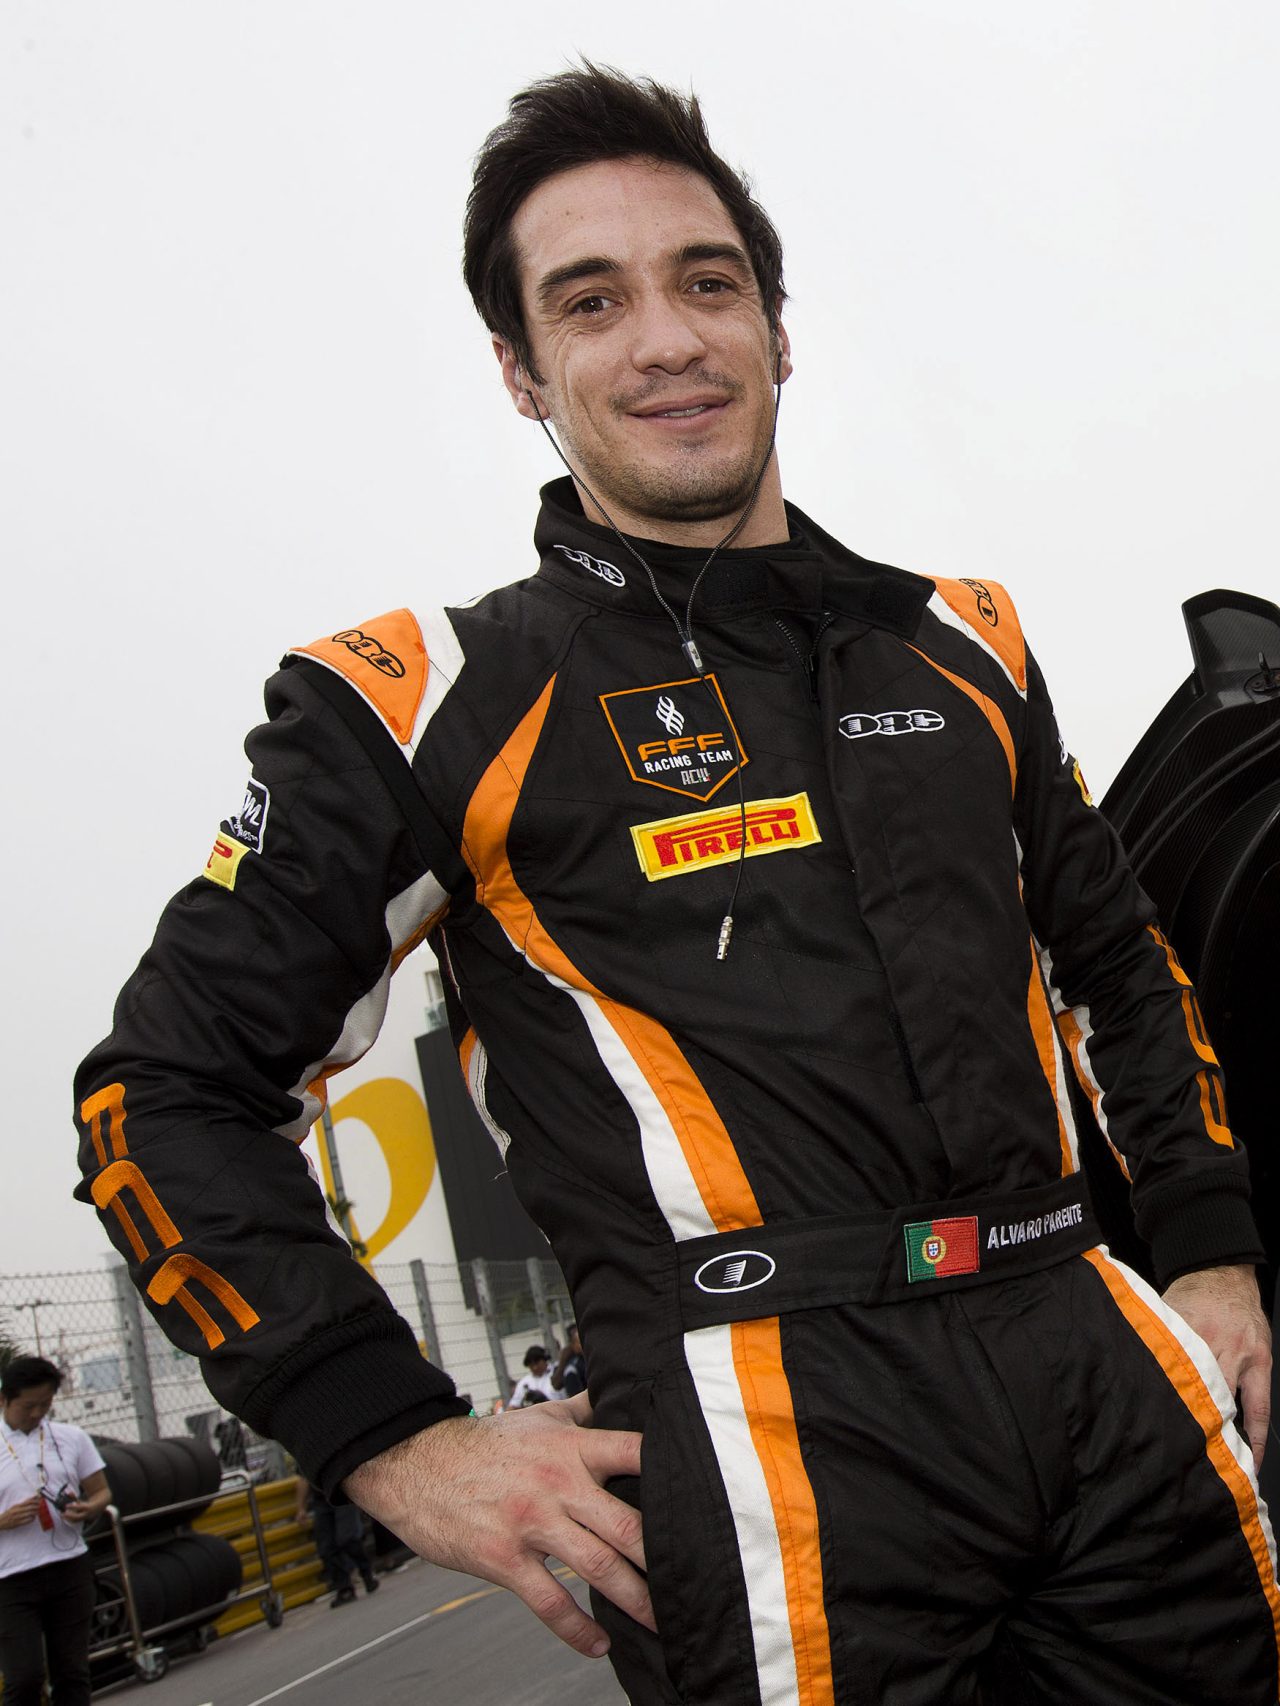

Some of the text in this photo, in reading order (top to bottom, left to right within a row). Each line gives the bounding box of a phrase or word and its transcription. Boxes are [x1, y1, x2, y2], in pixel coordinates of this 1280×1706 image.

[637, 732, 725, 762] FFF
[643, 750, 734, 774] RACING TEAM
[653, 807, 801, 867] PIRELLI
[987, 1203, 1083, 1250] ALVARO PARENTE
